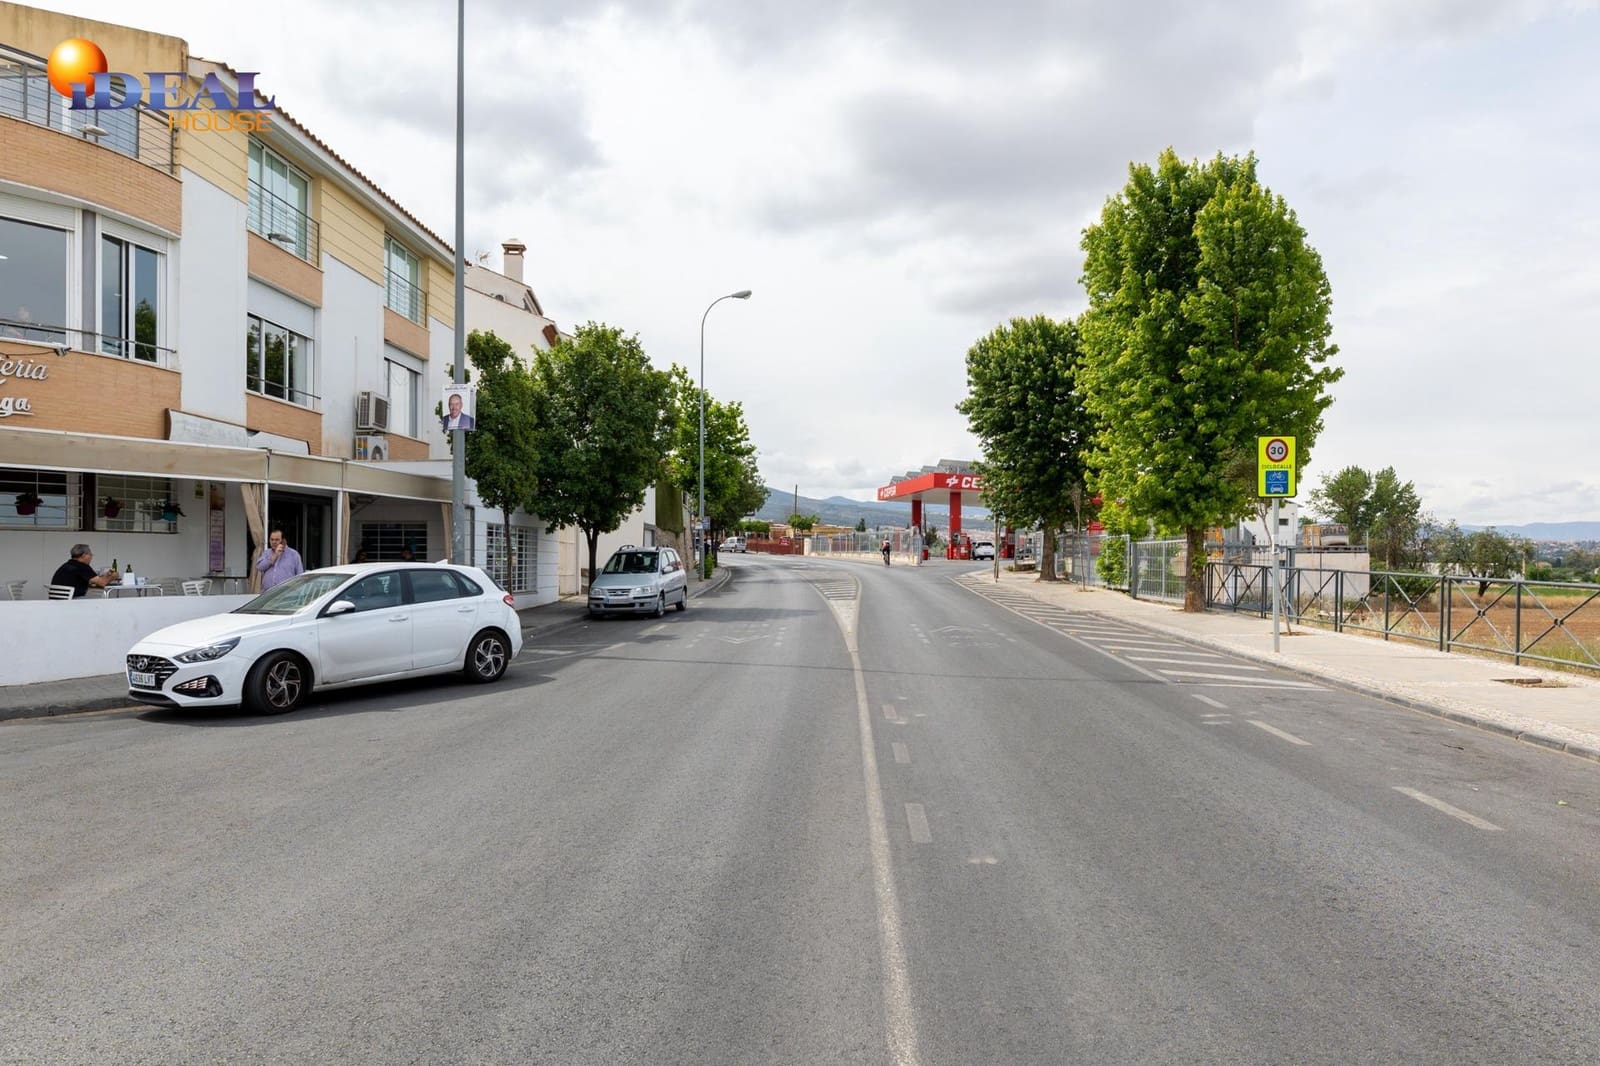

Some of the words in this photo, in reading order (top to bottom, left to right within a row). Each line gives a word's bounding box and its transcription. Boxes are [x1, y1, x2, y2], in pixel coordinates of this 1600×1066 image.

[0, 397, 33, 417] ga
[1270, 446, 1284, 455] 30
[961, 476, 983, 488] CE
